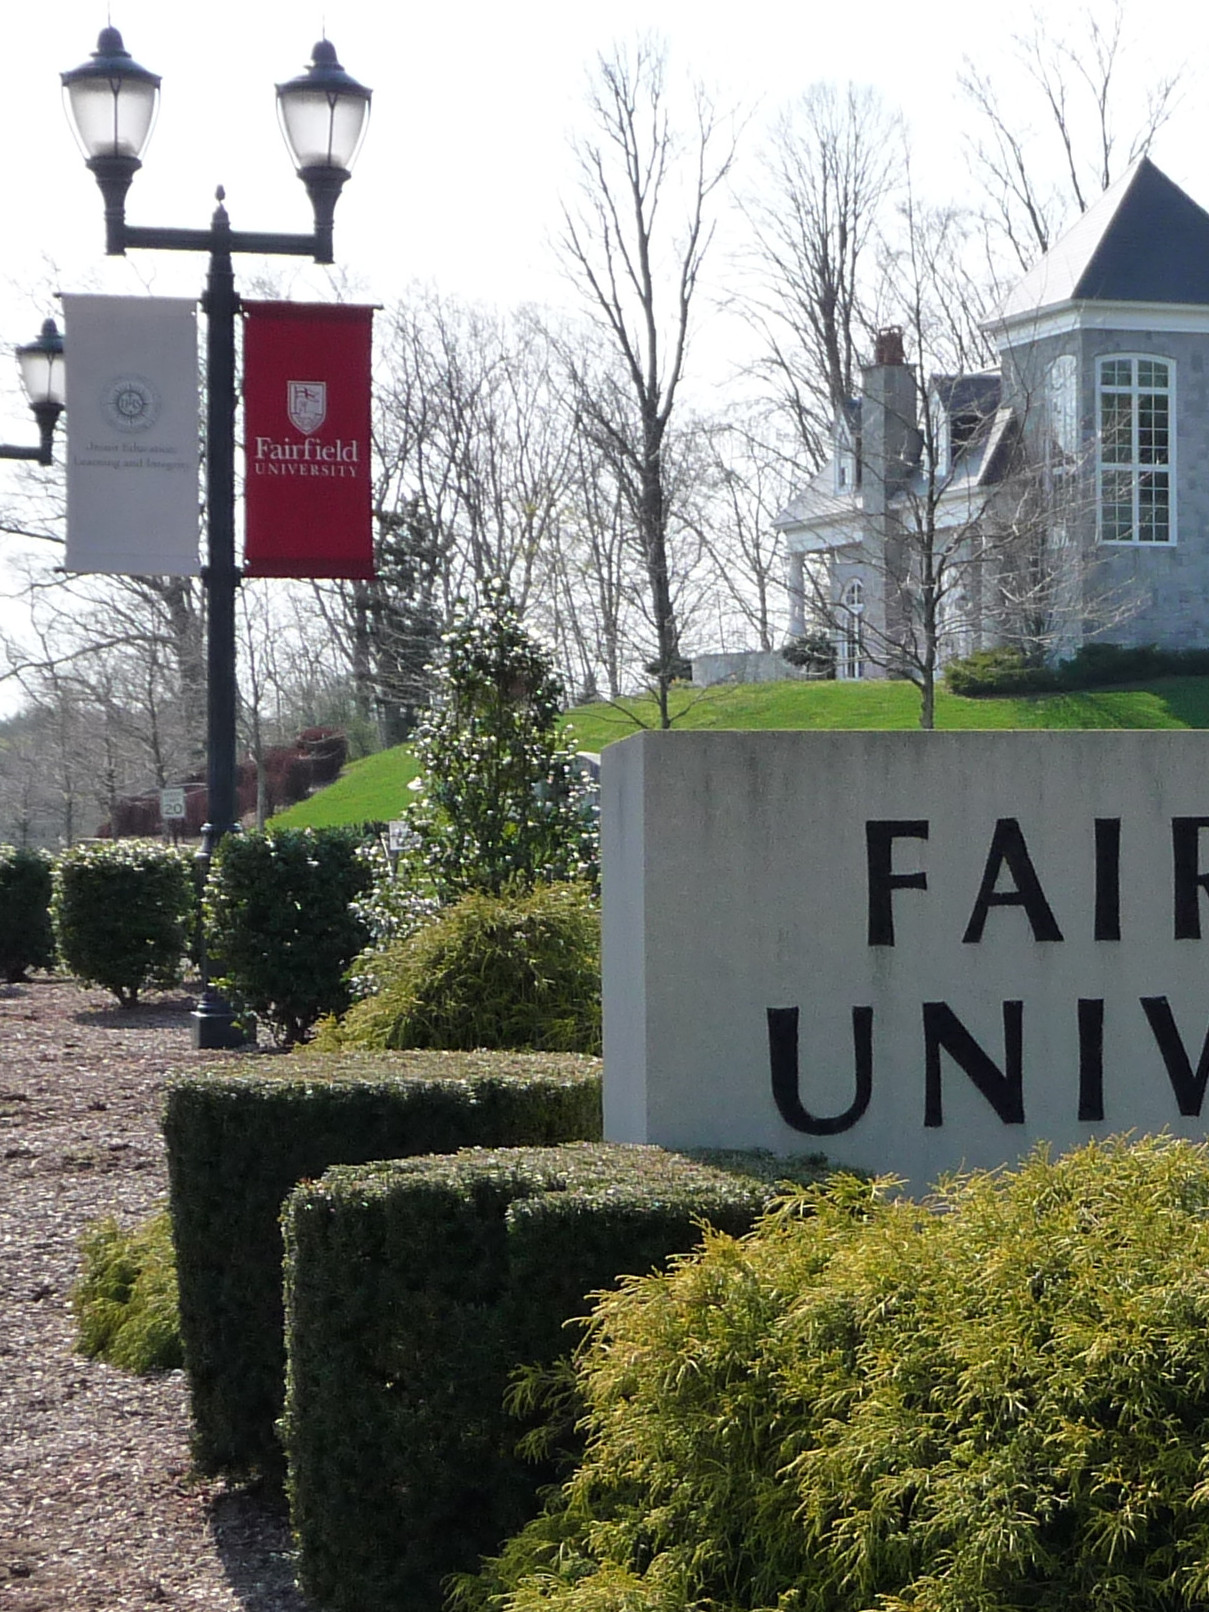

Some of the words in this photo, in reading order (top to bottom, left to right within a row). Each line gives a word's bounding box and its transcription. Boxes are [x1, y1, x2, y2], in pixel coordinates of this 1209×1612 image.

[255, 436, 359, 463] Fairfield
[255, 463, 358, 478] UNIVERSITY
[164, 803, 183, 815] 20
